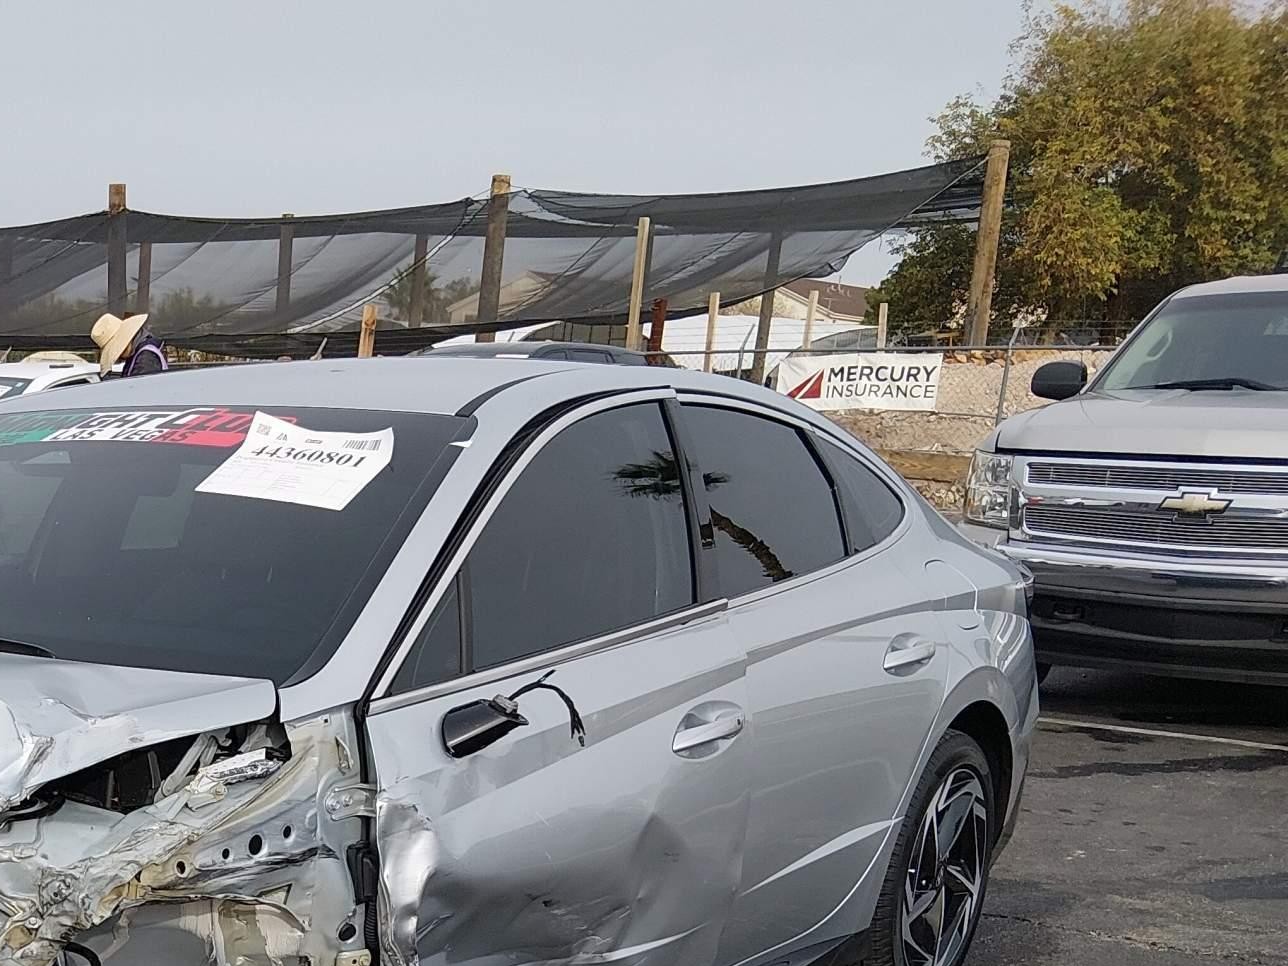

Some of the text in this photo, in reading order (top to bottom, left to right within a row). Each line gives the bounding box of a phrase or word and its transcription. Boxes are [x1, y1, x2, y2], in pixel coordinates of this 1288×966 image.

[829, 366, 937, 382] MERCURY
[826, 384, 937, 399] INSURANCE
[155, 409, 253, 432] CLU
[50, 429, 196, 443] LAS VEGAS
[251, 445, 368, 468] 44360801
